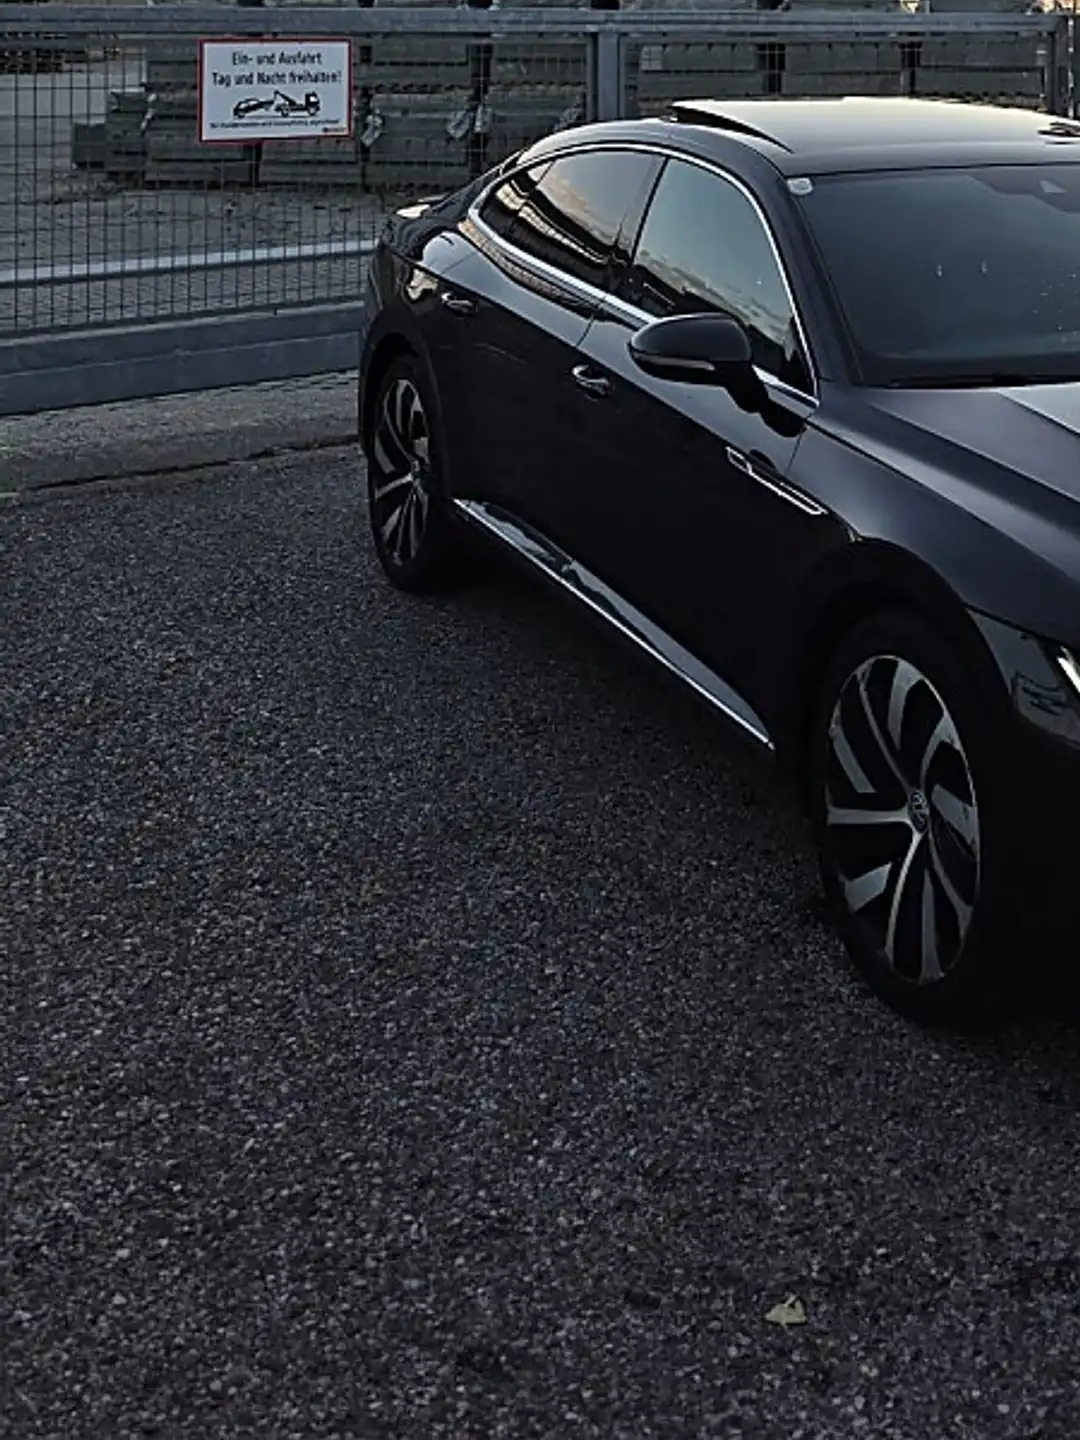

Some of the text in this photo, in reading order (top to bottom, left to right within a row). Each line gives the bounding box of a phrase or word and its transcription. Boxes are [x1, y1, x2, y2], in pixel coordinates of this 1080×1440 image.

[231, 50, 323, 66] Ein- und Ausfahrt
[211, 70, 343, 88] Tag und Nacht freihalten!
